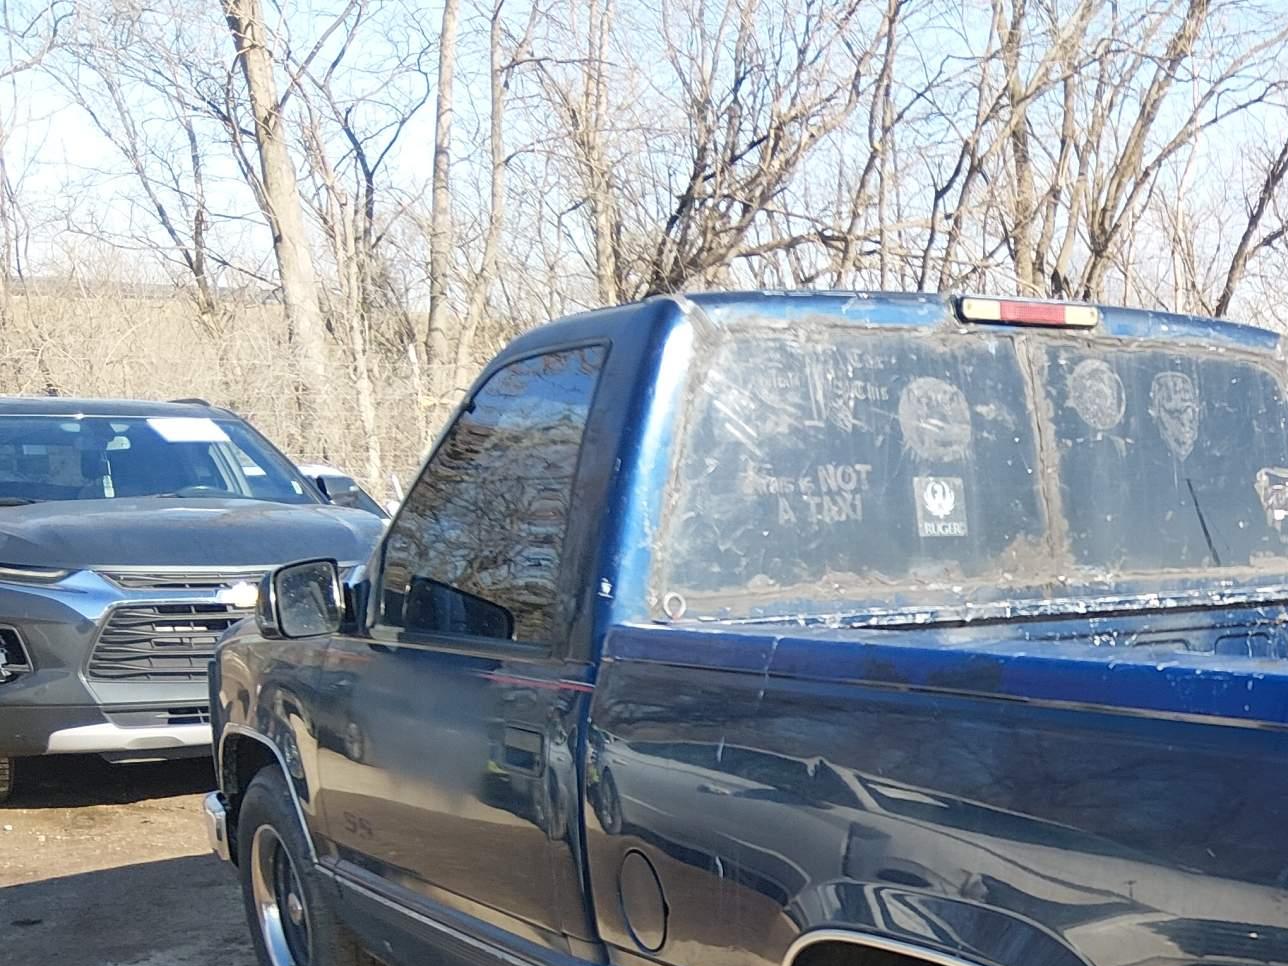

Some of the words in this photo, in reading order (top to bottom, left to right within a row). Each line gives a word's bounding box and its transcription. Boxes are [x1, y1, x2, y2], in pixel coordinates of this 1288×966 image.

[817, 463, 873, 493] NOT
[779, 495, 797, 524] A
[924, 521, 961, 535] RUGER
